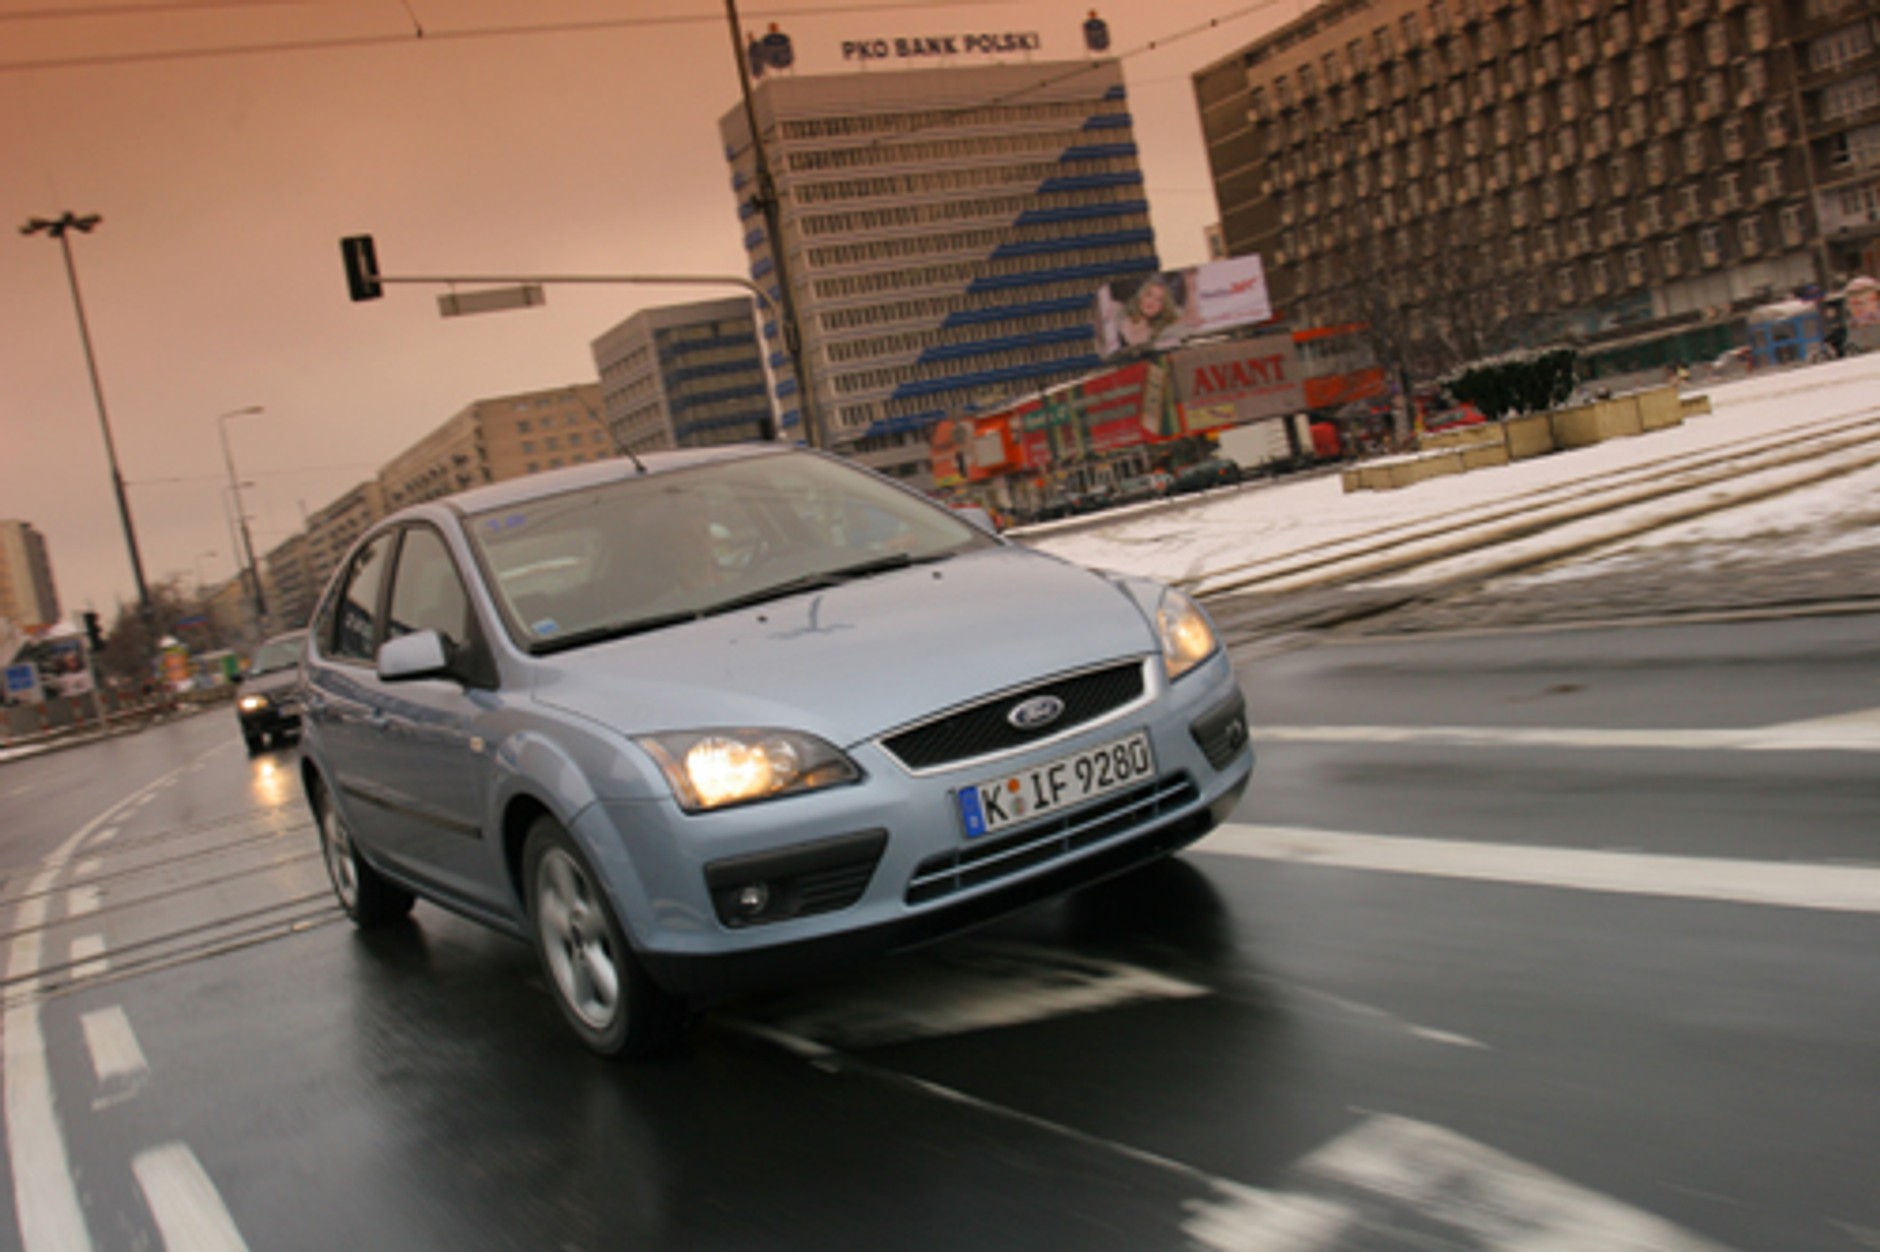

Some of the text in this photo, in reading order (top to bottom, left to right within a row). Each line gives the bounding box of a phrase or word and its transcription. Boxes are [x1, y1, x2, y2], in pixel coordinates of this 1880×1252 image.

[842, 31, 1041, 60] PKO BANK POLSKI
[1191, 353, 1286, 396] AVANT
[982, 738, 1149, 825] K IF 9280
